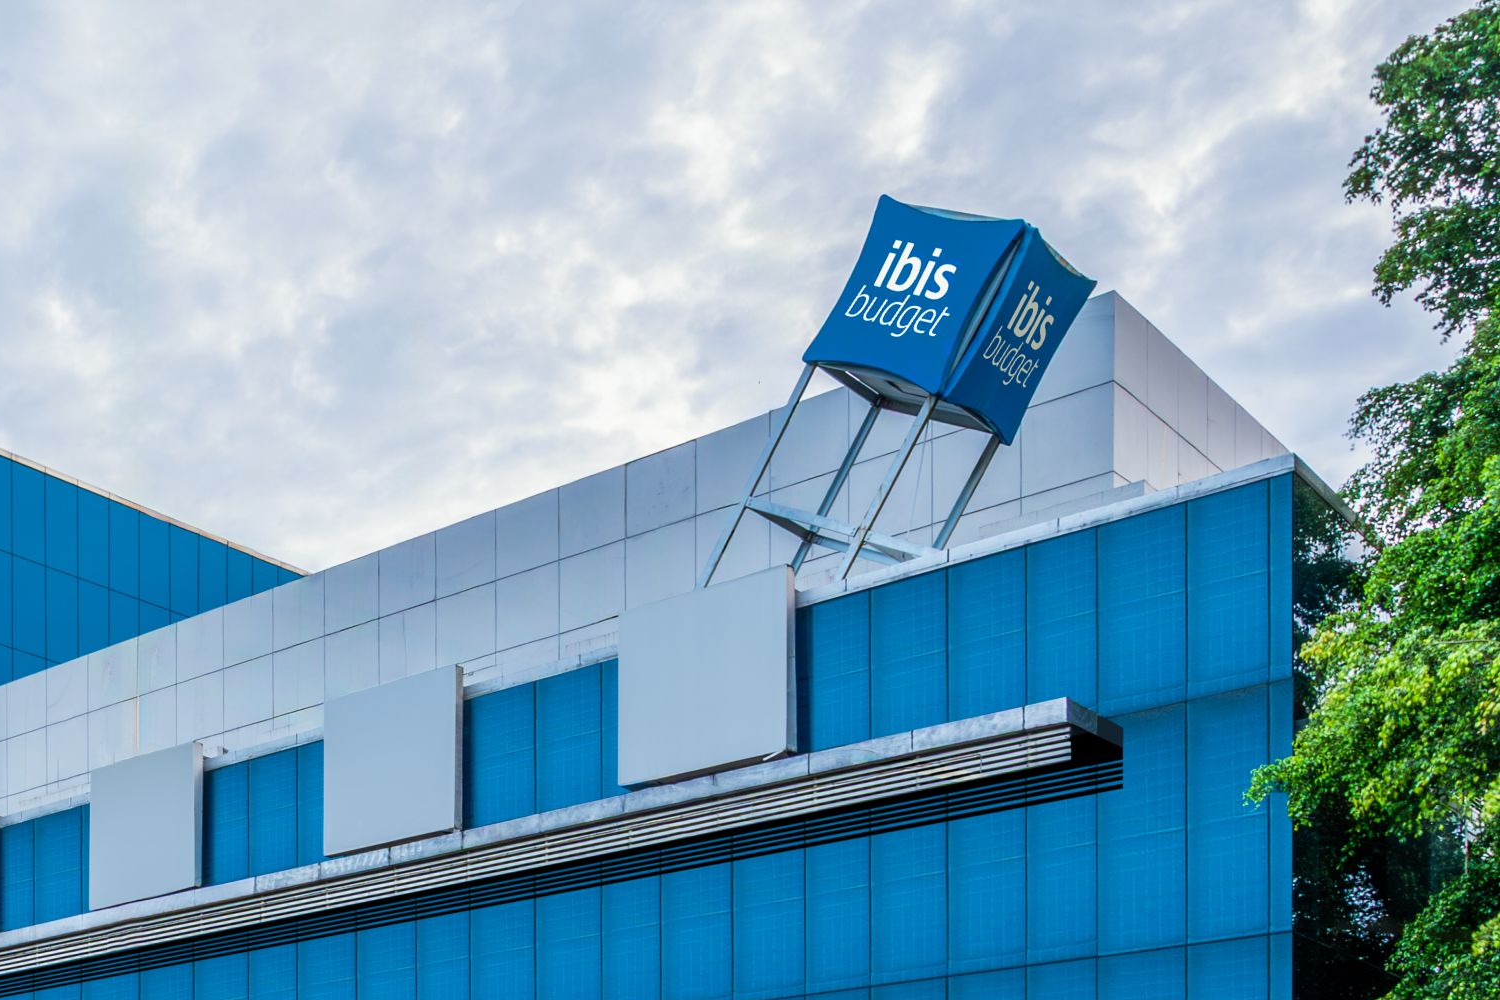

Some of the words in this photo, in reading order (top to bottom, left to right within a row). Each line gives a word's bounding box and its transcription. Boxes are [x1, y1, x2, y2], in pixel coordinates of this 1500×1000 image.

[874, 239, 957, 300] ibis
[845, 284, 950, 338] budget
[1007, 280, 1055, 351] ibis
[982, 325, 1040, 389] budget
